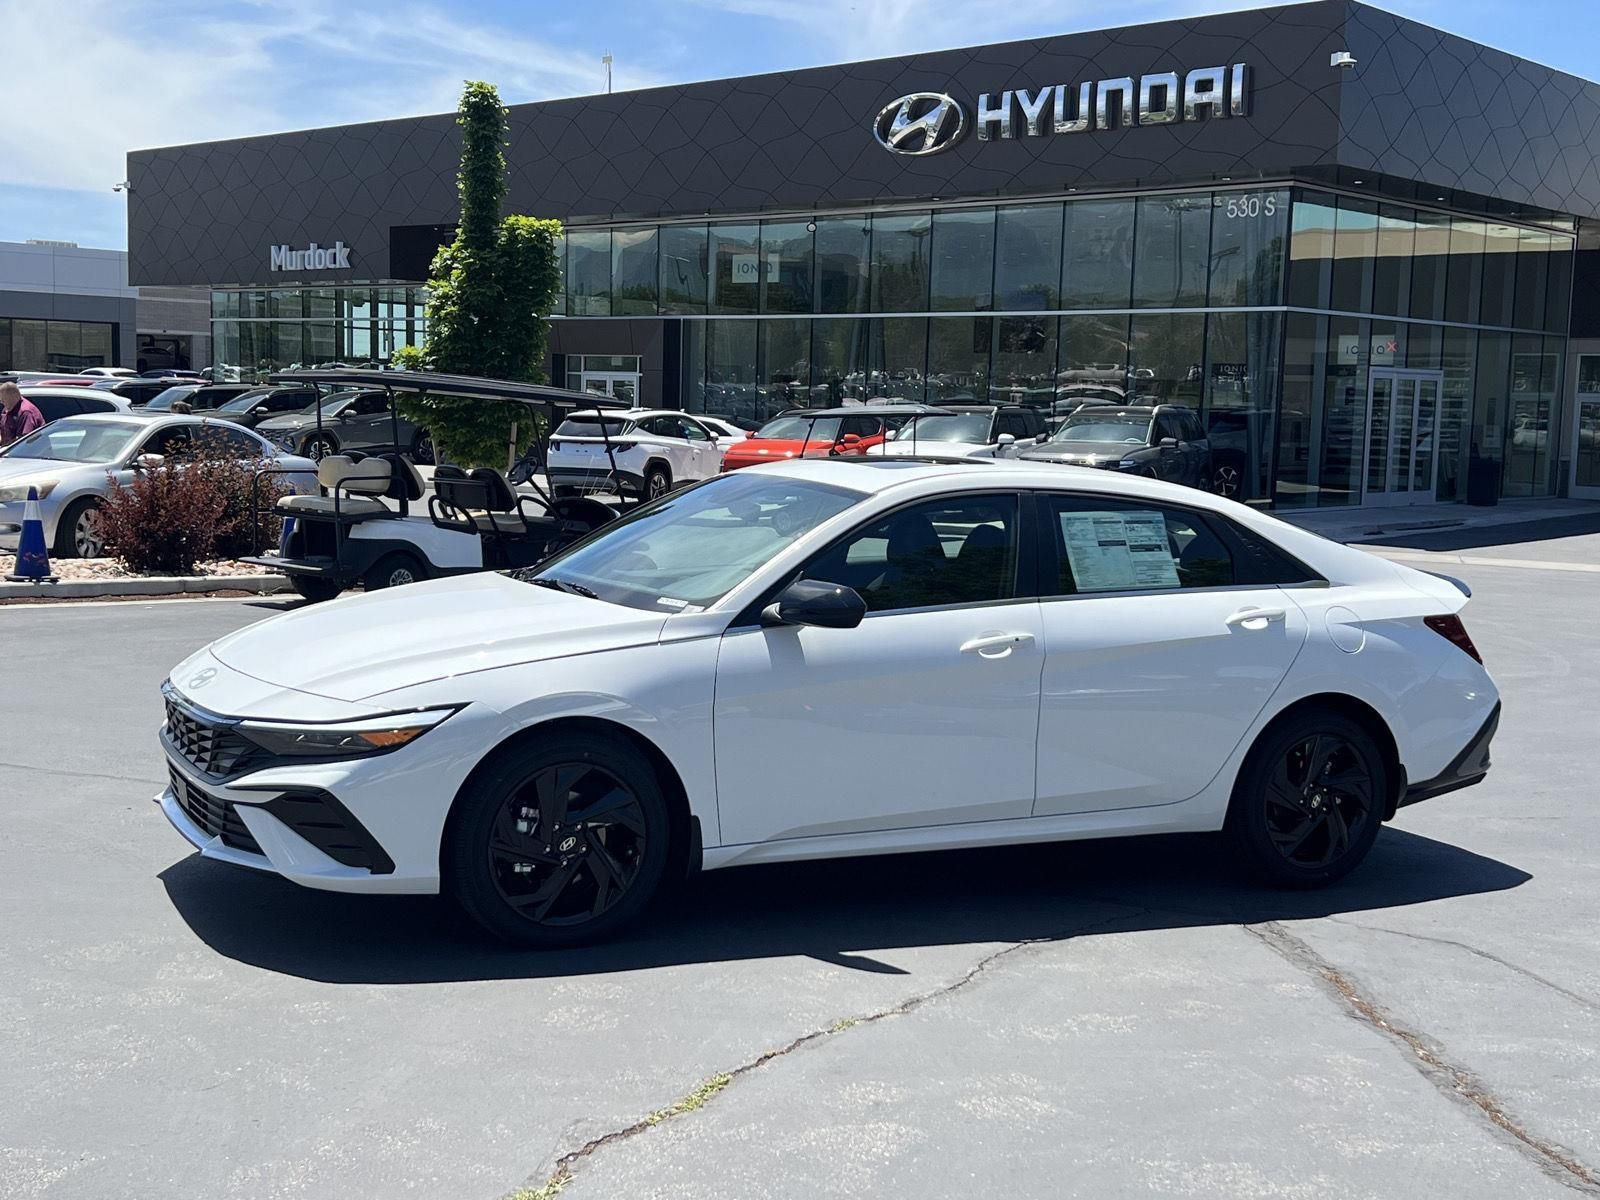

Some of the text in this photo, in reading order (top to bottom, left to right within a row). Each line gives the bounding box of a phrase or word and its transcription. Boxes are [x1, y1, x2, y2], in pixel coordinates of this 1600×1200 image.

[977, 63, 1248, 141] HYUNDAI
[1227, 197, 1276, 218] 530 S
[270, 241, 351, 272] Murdock
